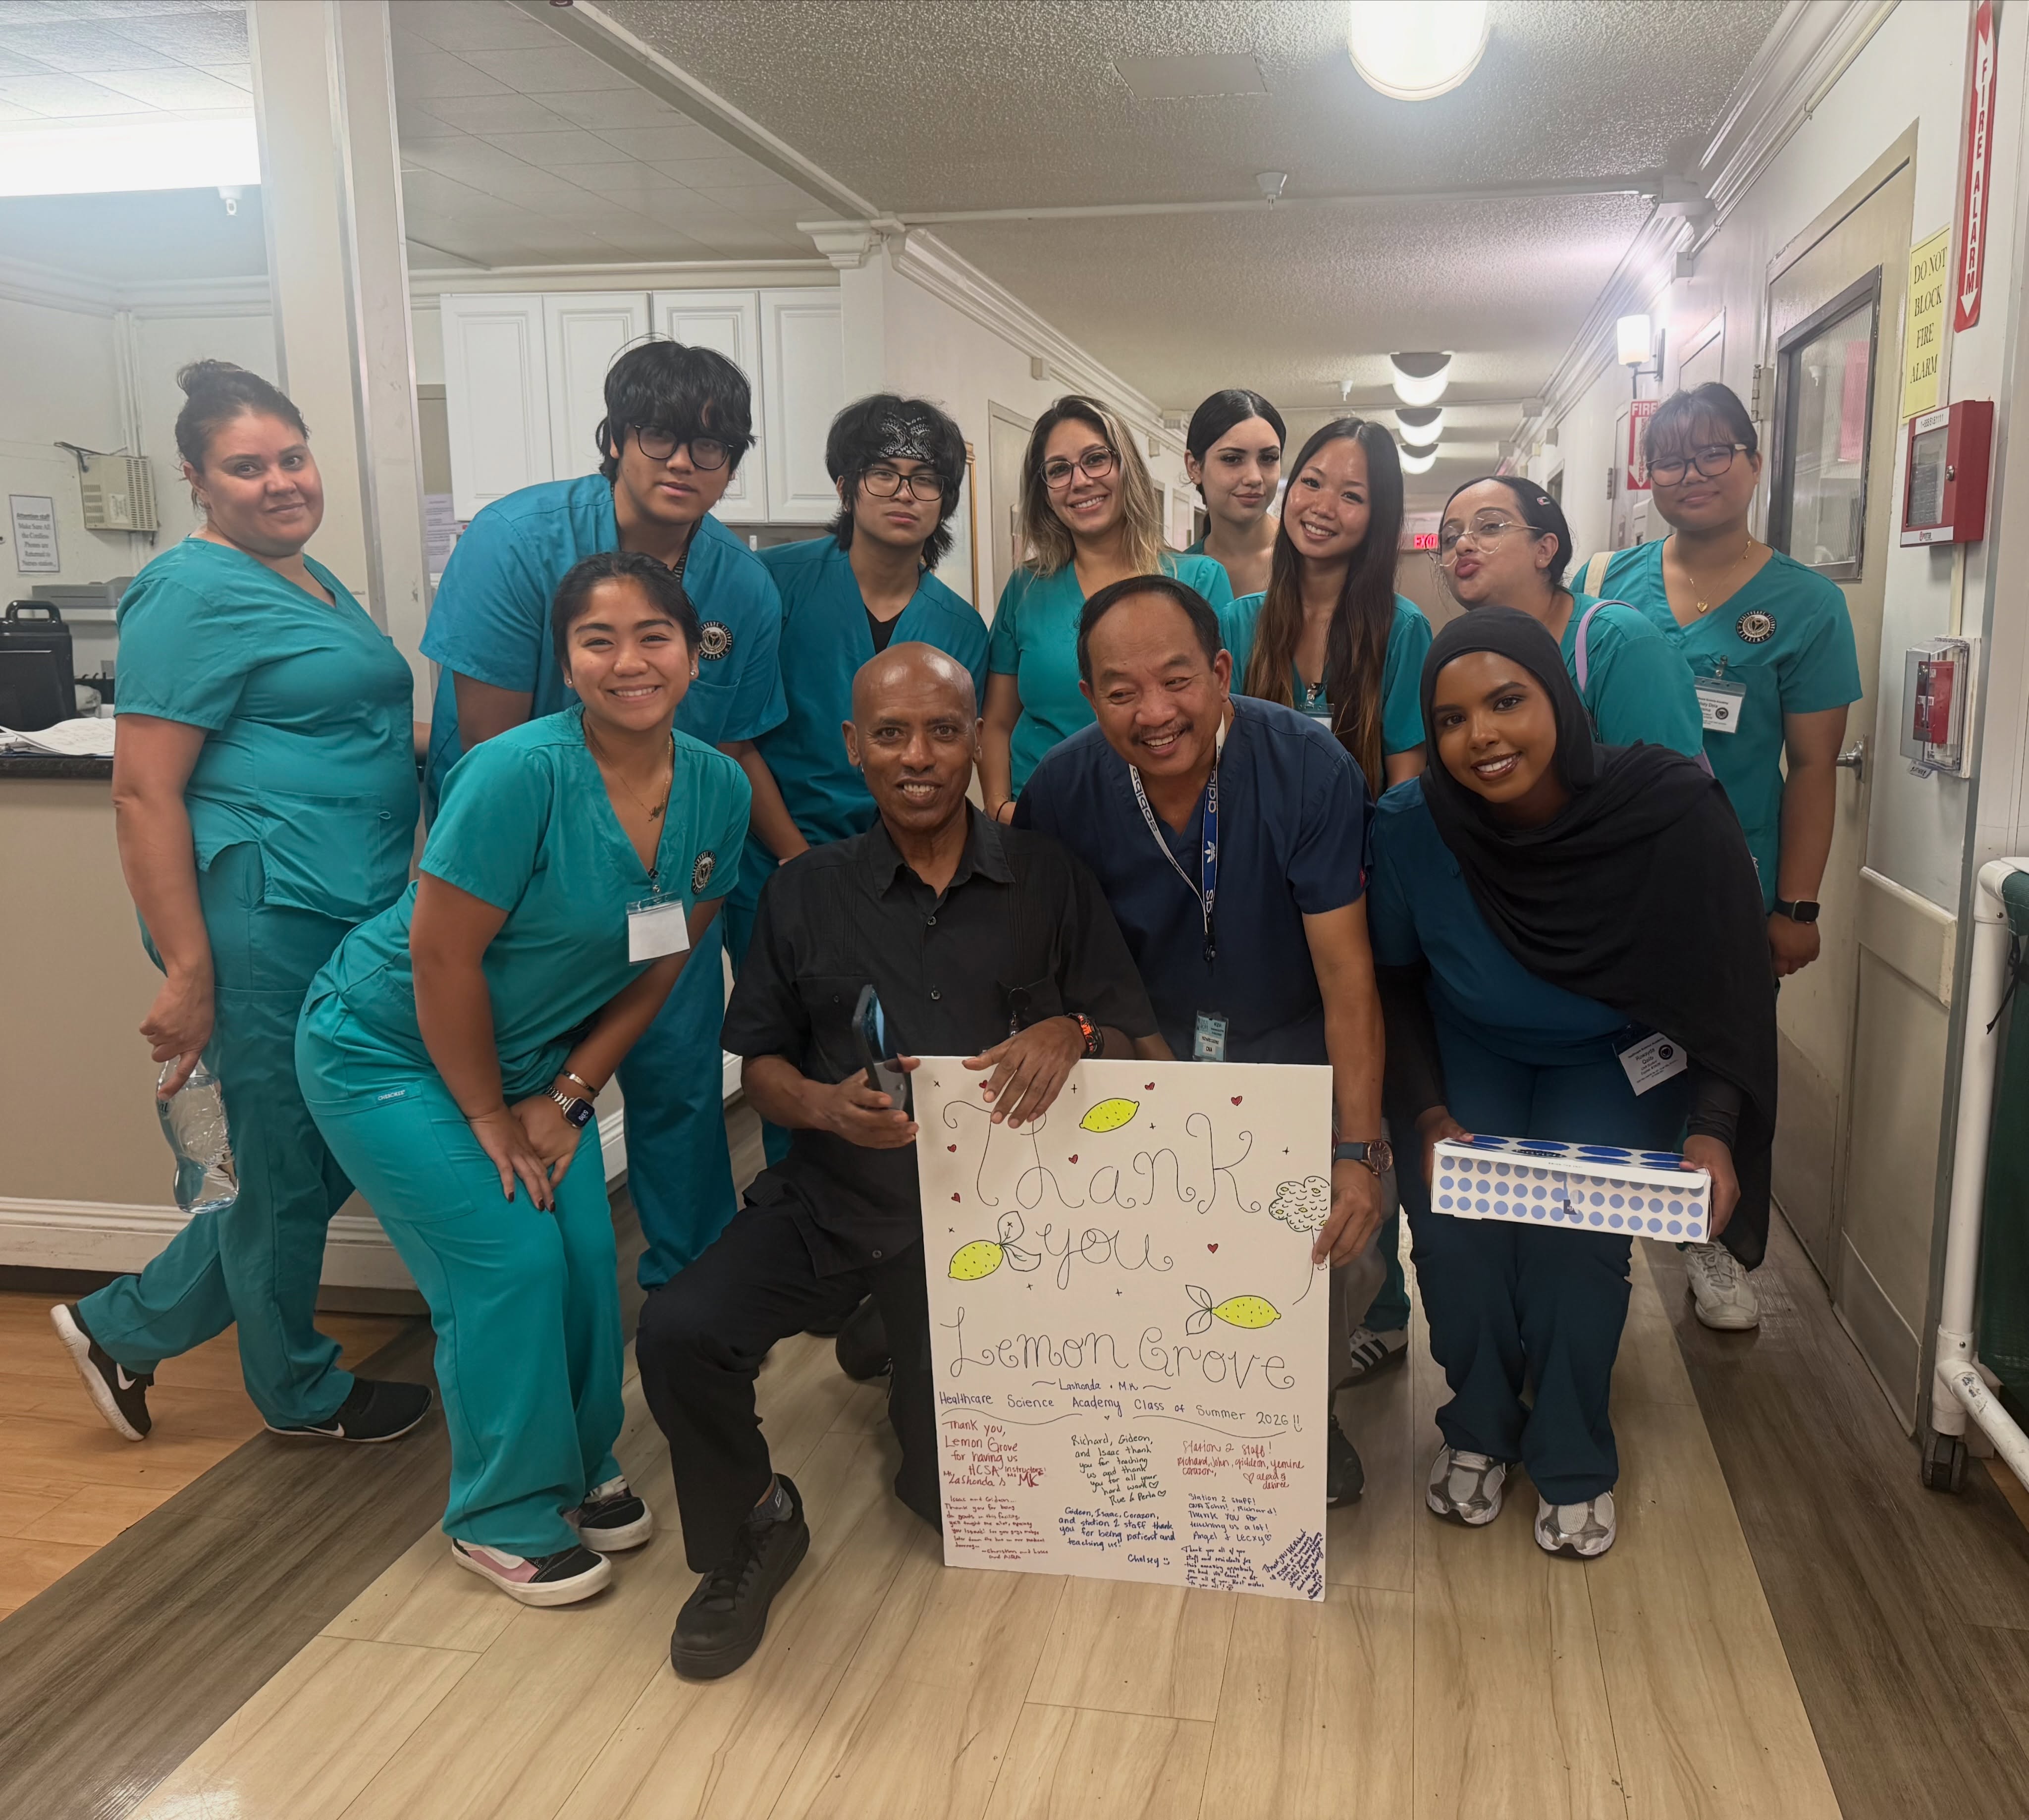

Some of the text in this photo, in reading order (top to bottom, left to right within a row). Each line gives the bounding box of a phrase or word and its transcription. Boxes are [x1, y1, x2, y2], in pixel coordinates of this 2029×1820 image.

[1965, 57, 1988, 296] FIRE ALARM
[1914, 246, 1947, 284] DO NOT
[1915, 284, 1942, 317] BLOCK
[1917, 322, 1934, 348] FIRE
[1910, 354, 1938, 384] ALARM
[1632, 403, 1657, 416] FIRE
[1132, 768, 1158, 833] adidas
[944, 1100, 1261, 1214] Thank
[1036, 1224, 1174, 1290] you
[940, 1306, 1295, 1390] Lemon Grove
[1059, 1378, 1102, 1391] Lashonda
[939, 1391, 994, 1405] Healthcare
[1007, 1394, 1055, 1407] Science
[1072, 1395, 1122, 1418] Academy
[1134, 1399, 1165, 1411] Class
[1175, 1404, 1185, 1413] of
[1196, 1405, 1246, 1420] Summer
[1256, 1411, 1289, 1426] 2026
[984, 1425, 1006, 1437] you,
[945, 1435, 1018, 1453] Lemon Grove
[1071, 1433, 1153, 1446] Richard, Gideon,
[1183, 1440, 1221, 1454] Station
[1226, 1443, 1234, 1452] 2
[1075, 1445, 1152, 1458] and Isaac thank
[951, 1450, 965, 1461] for
[972, 1451, 1004, 1470] having
[1079, 1456, 1148, 1473] you for teaching
[969, 1463, 1000, 1477] HCSA
[1103, 1466, 1117, 1477] and
[1121, 1463, 1146, 1474] thank
[1090, 1480, 1103, 1493] you
[1108, 1476, 1120, 1484] for
[1141, 1474, 1157, 1483] your
[1101, 1481, 1147, 1496] hard work
[1109, 1491, 1156, 1506] Rue Perla
[1189, 1493, 1217, 1502] Station
[1065, 1506, 1159, 1520] Gideon, Isaac, Corazon,
[1188, 1510, 1219, 1520] Thank
[1080, 1518, 1110, 1527] station
[1114, 1518, 1120, 1527] 2
[1123, 1520, 1146, 1530] staff
[1152, 1520, 1174, 1530] thank
[1190, 1521, 1227, 1533] teaching
[1253, 1524, 1270, 1533] lot!
[1059, 1526, 1175, 1542] you for being patient and
[1193, 1531, 1218, 1544] Angel
[1067, 1537, 1122, 1551] teaching us!
